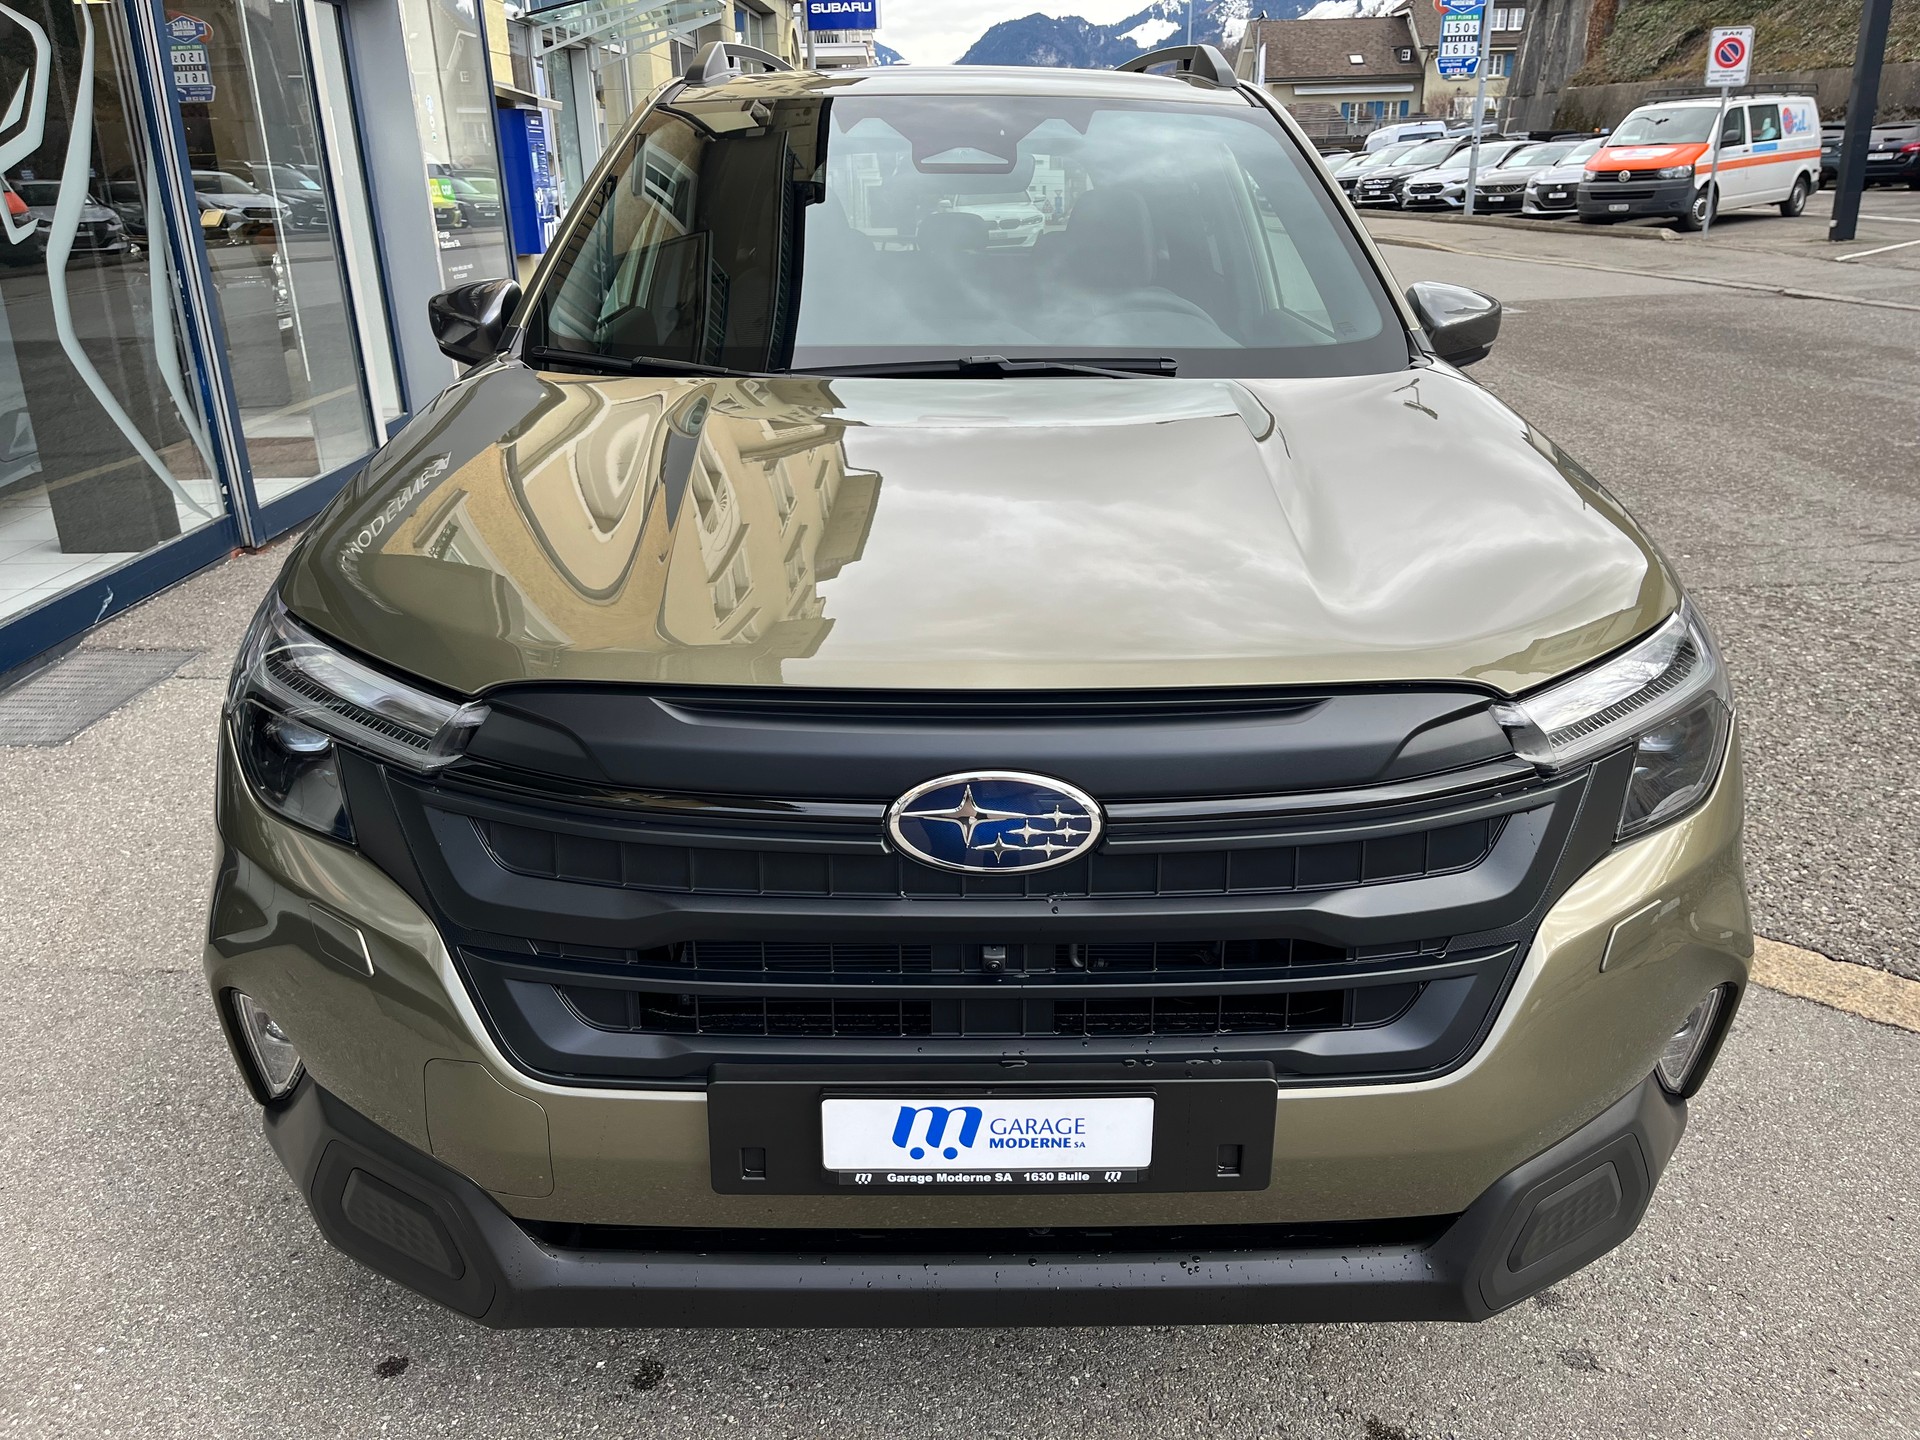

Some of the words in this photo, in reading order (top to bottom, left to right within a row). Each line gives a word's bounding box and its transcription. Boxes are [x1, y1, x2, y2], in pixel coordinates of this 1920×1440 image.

[810, 2, 872, 13] SUBARU
[989, 1117, 1086, 1135] GARAGE
[989, 1137, 1072, 1149] MODERNE
[1073, 1141, 1086, 1149] SA
[886, 1172, 934, 1184] Garage
[936, 1172, 992, 1183] Moderne
[994, 1172, 1013, 1182] SA
[1023, 1172, 1055, 1182] 1630
[1057, 1171, 1090, 1182] Bulle
